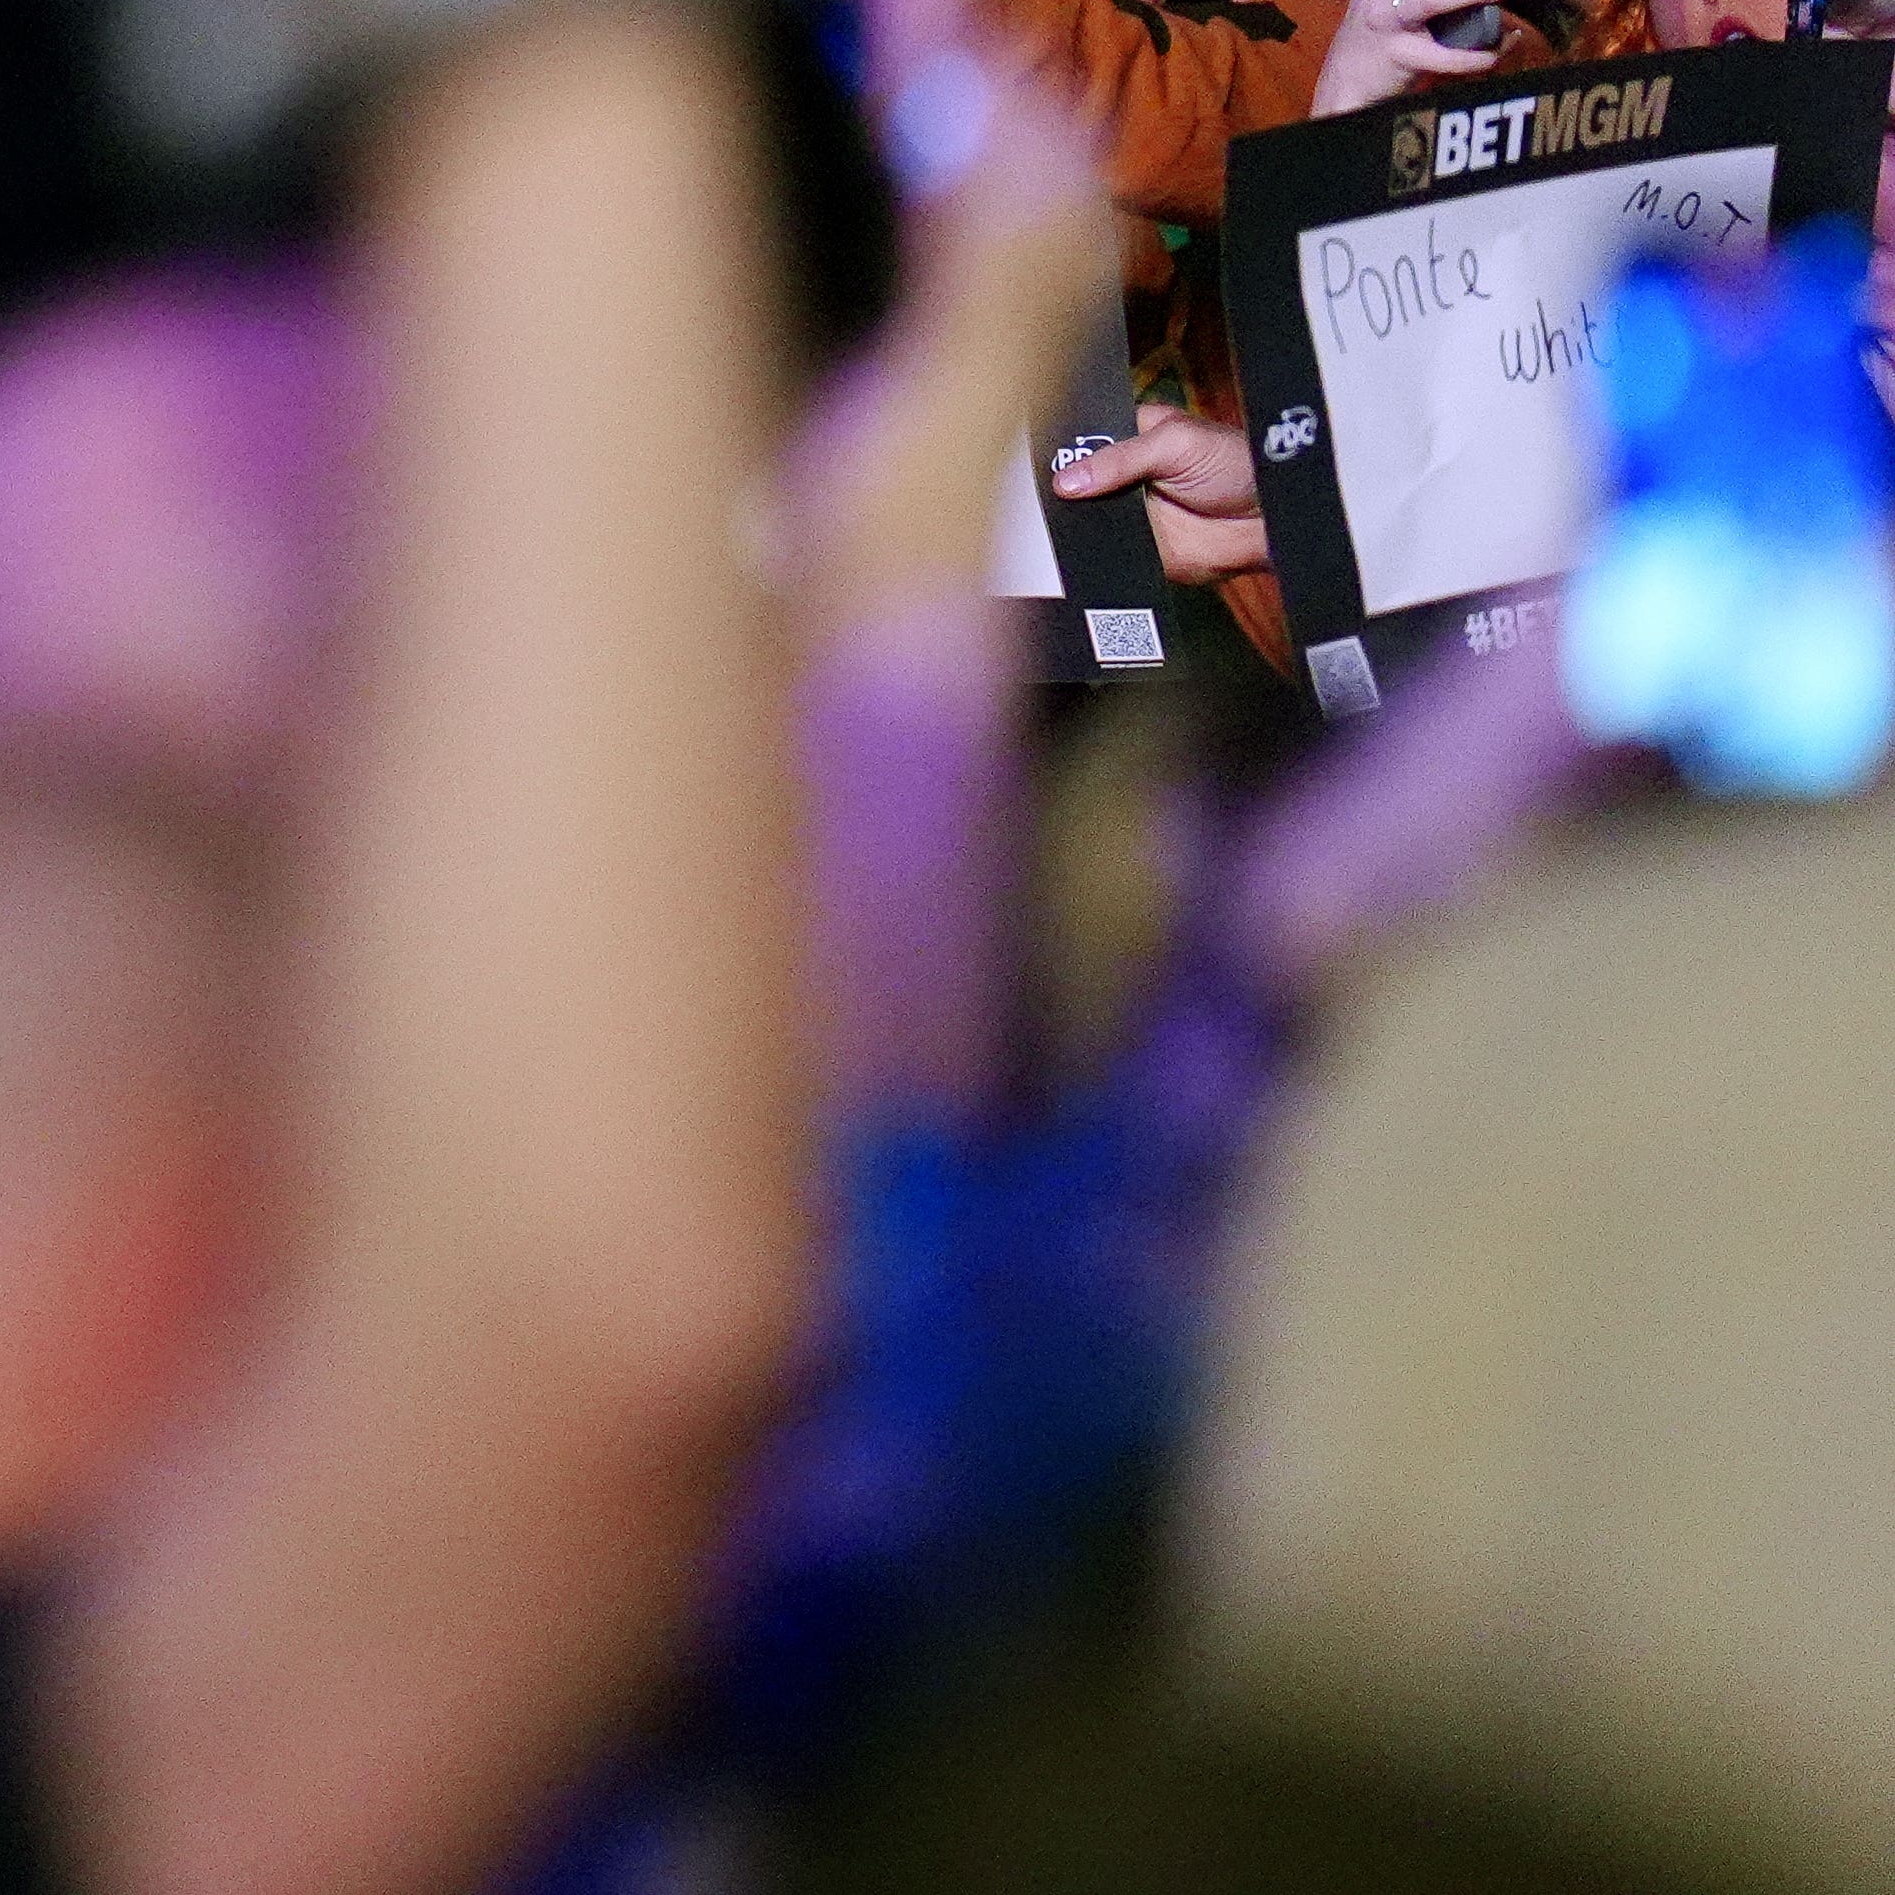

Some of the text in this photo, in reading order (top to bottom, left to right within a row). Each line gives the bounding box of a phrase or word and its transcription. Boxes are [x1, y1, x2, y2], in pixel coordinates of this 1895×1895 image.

[1434, 76, 1672, 178] BETMGM
[1319, 218, 1491, 355] Ponte
[1266, 416, 1315, 454] PDC
